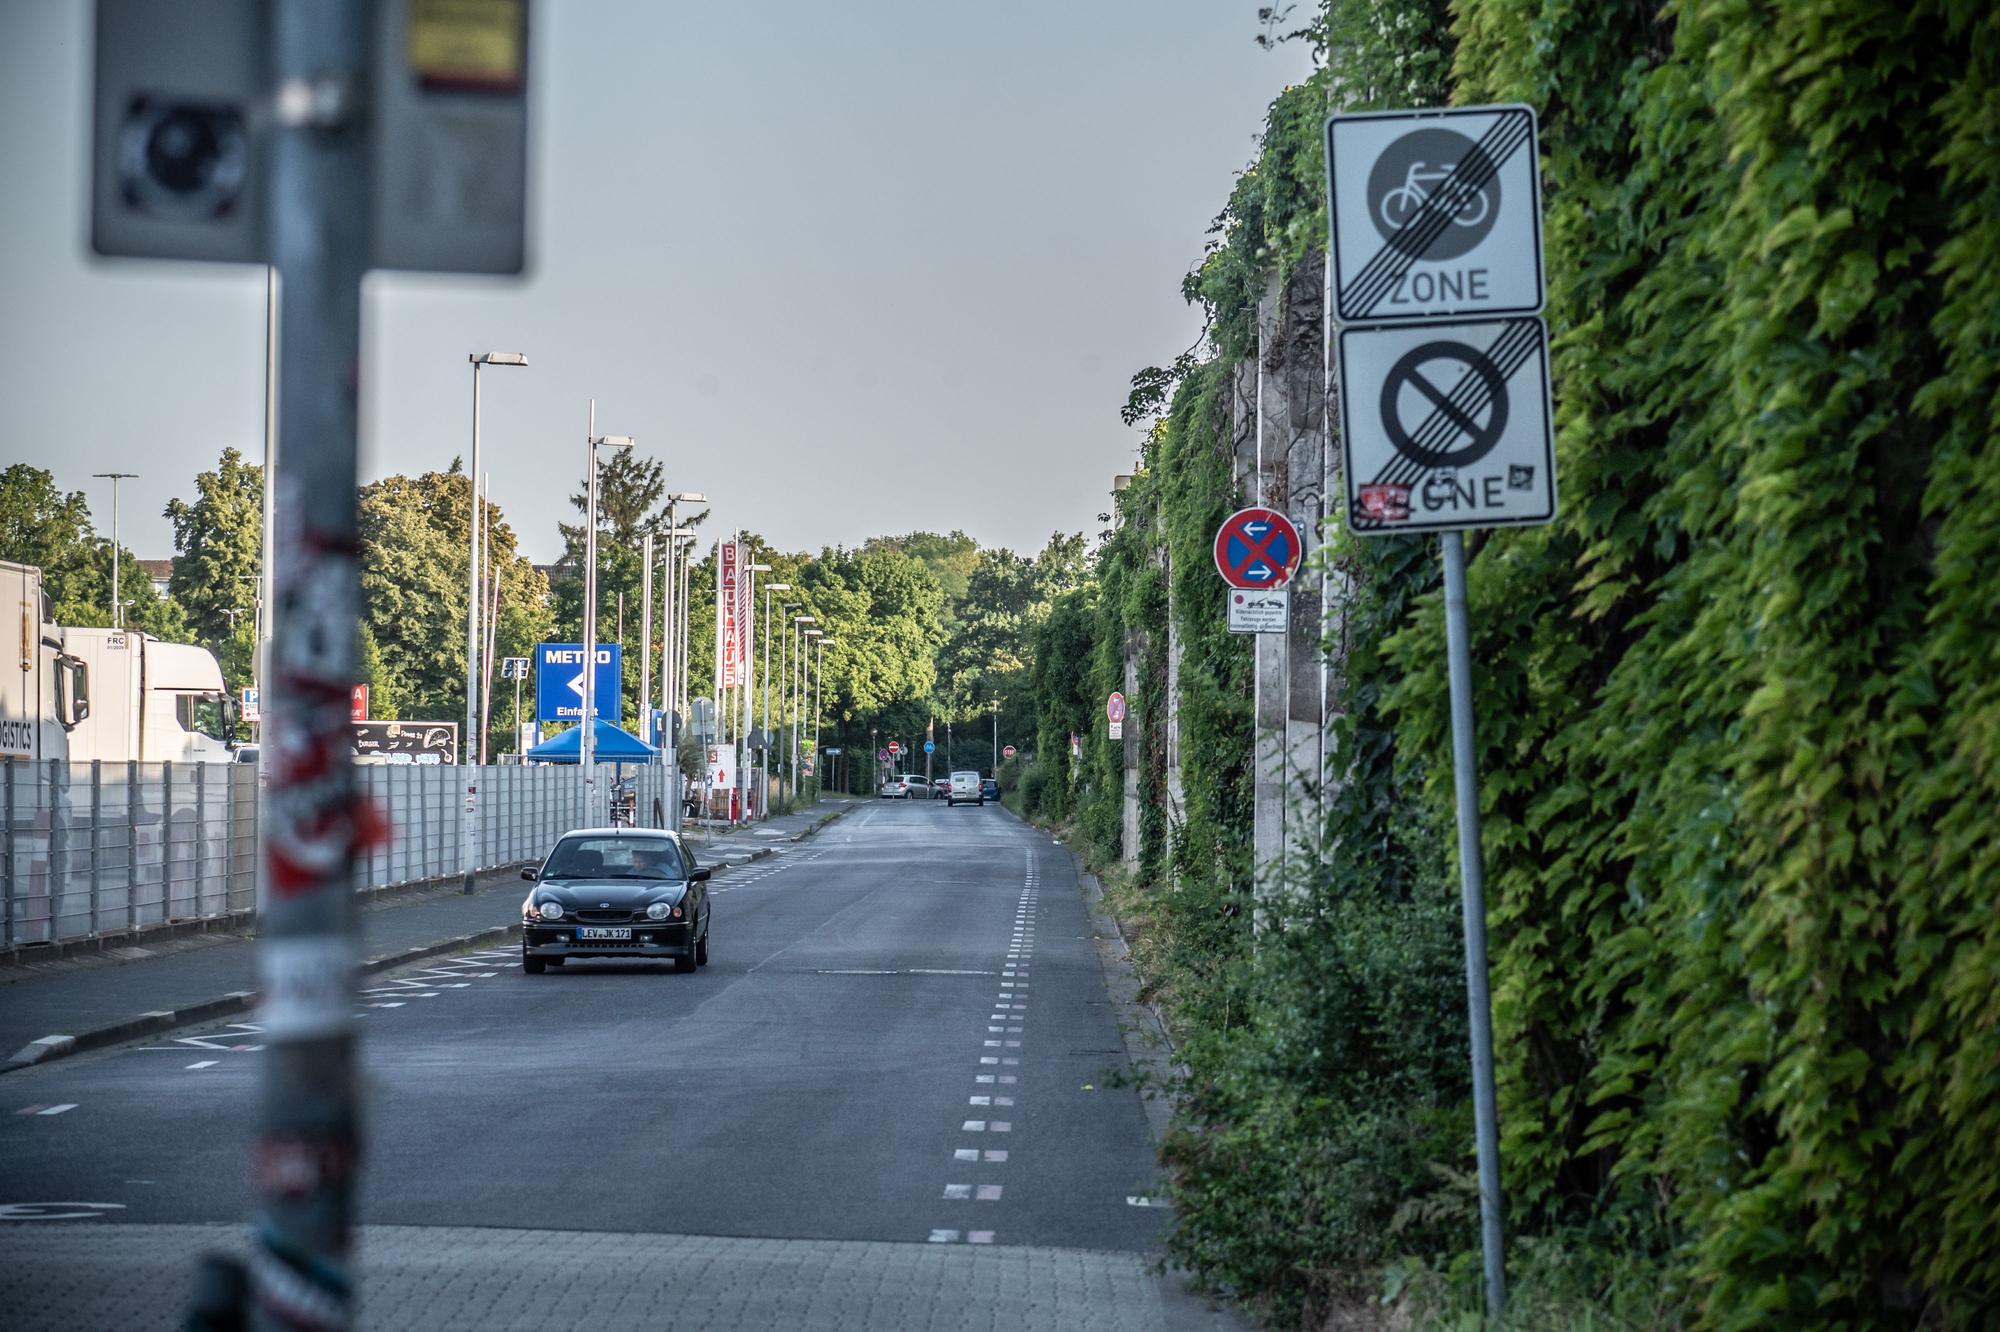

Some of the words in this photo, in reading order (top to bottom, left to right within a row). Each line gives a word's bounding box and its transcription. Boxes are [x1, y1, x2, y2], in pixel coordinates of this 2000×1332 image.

[1390, 268, 1490, 304] ZONE
[1404, 476, 1504, 512] ONE
[107, 637, 124, 645] FRC
[557, 706, 599, 716] Einfat
[582, 929, 598, 938] LEV
[615, 929, 630, 938] 171
